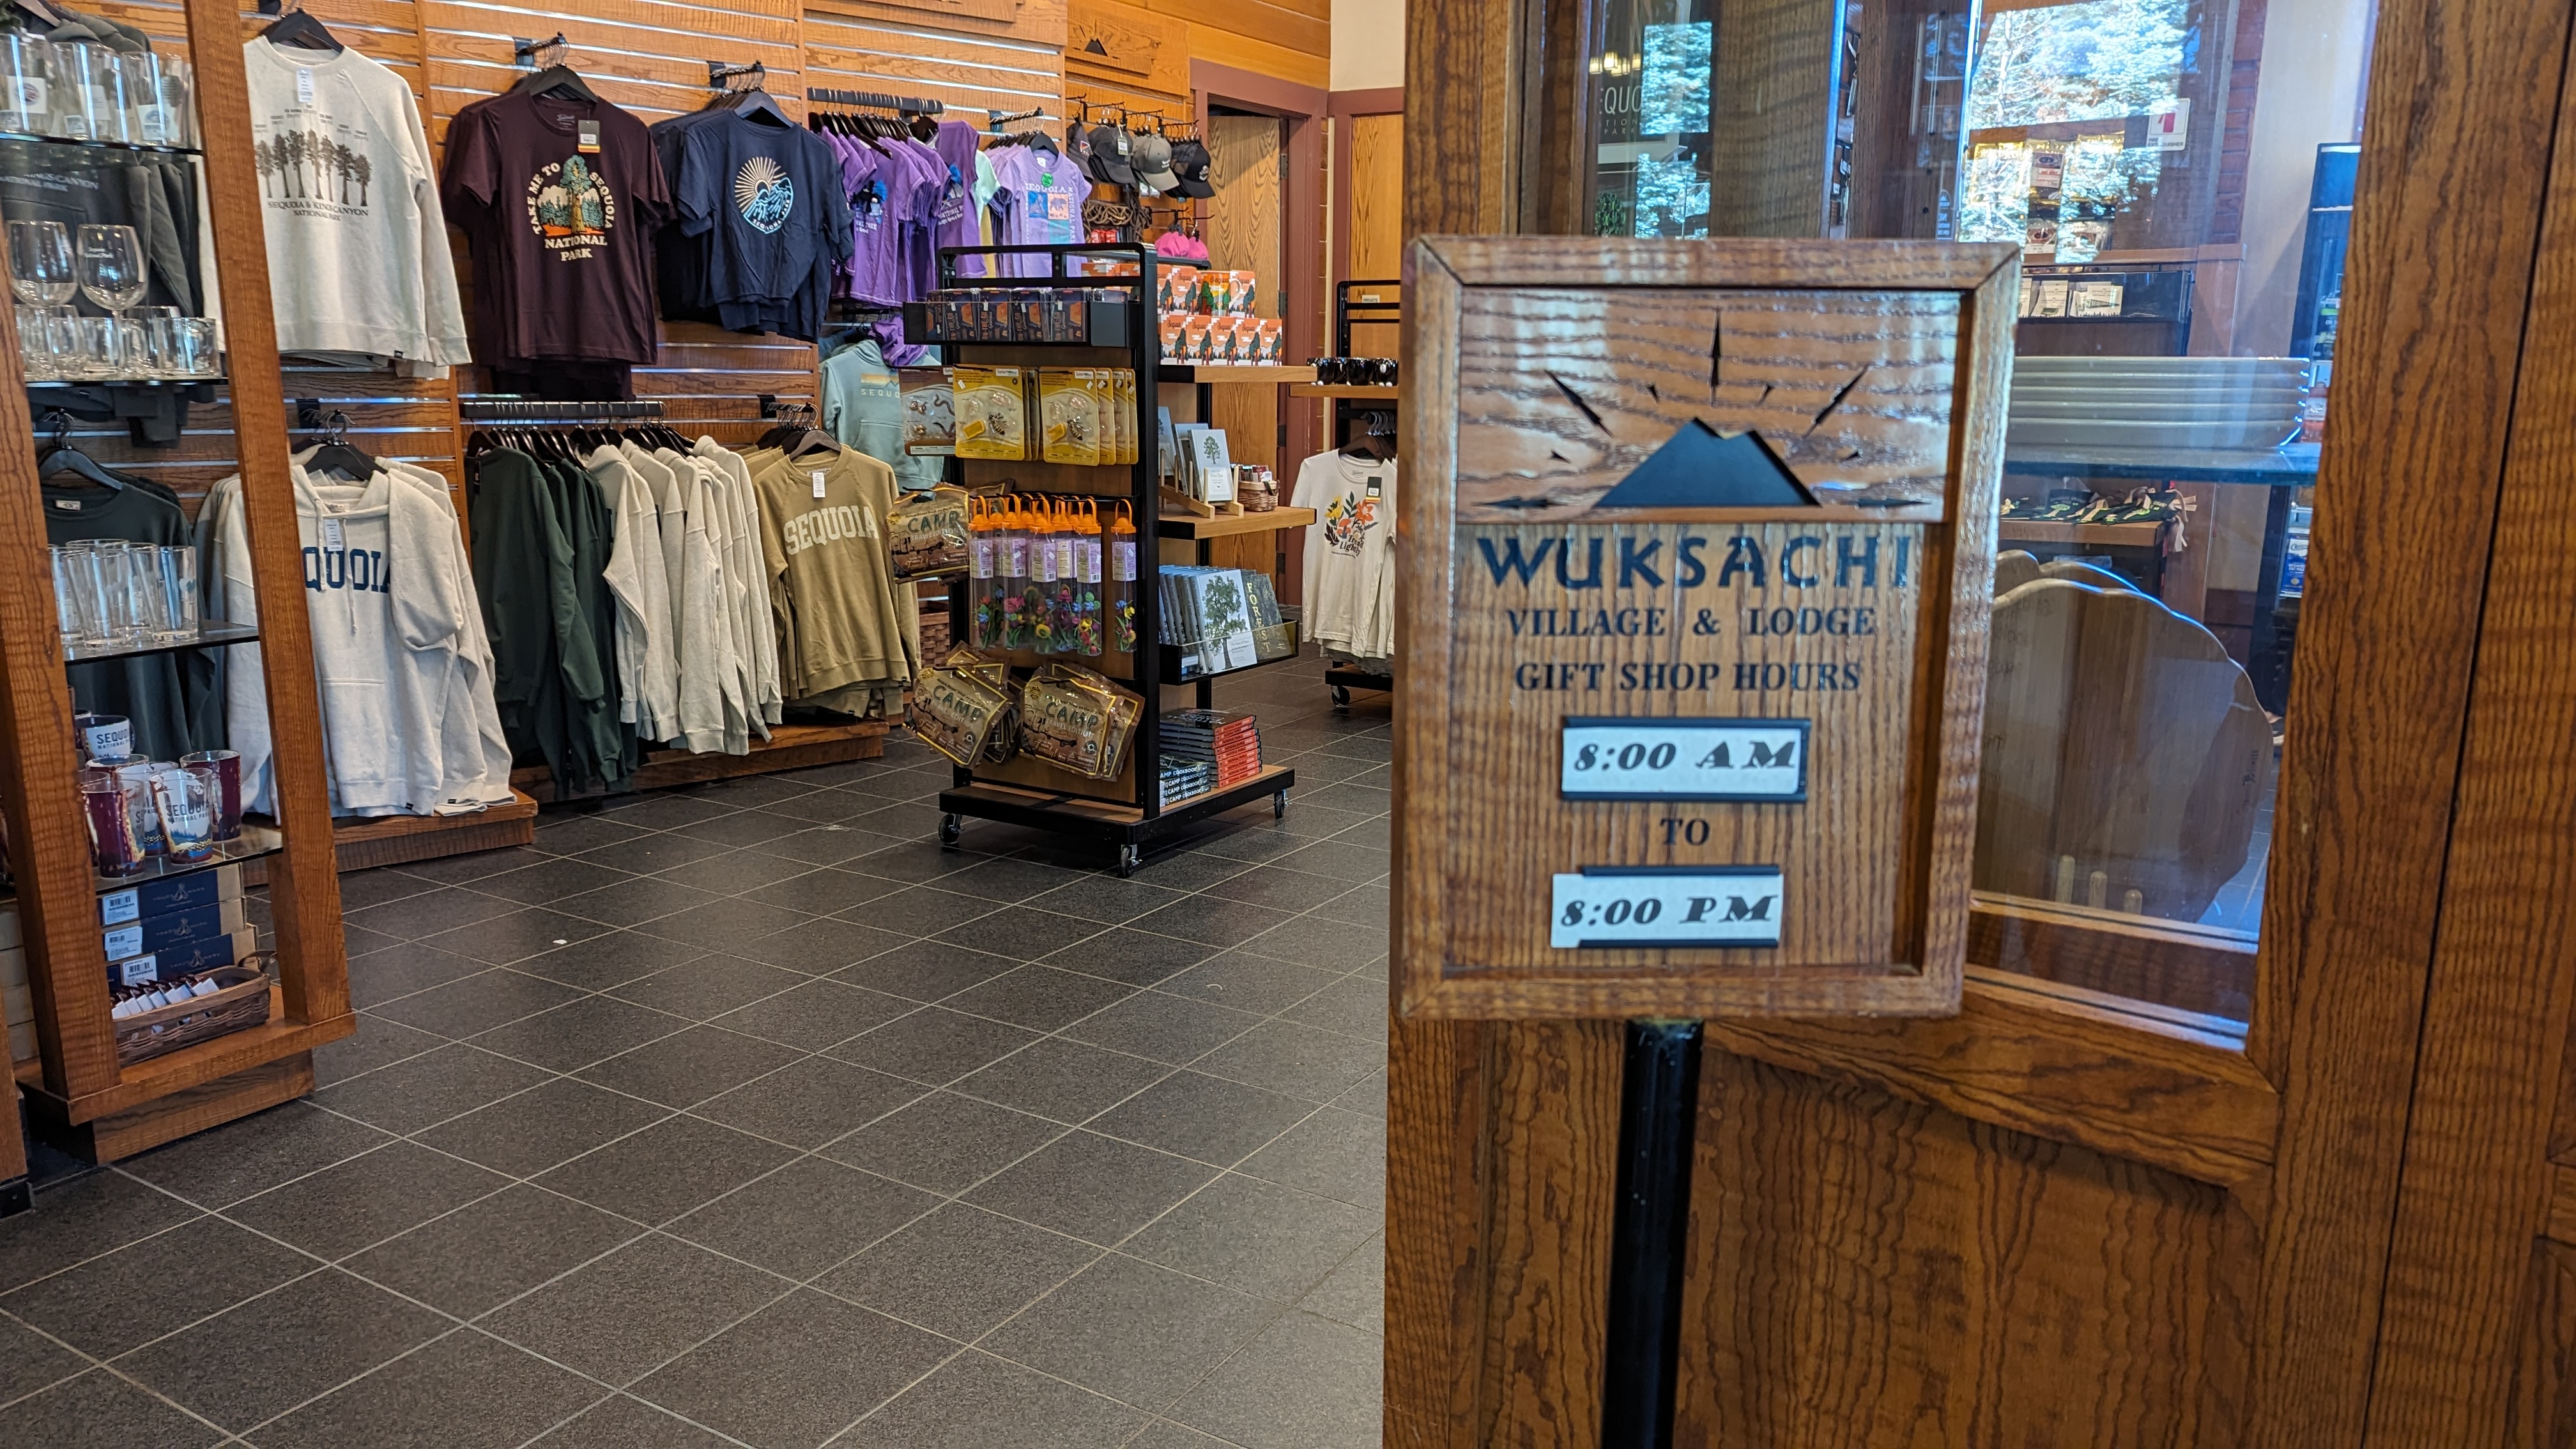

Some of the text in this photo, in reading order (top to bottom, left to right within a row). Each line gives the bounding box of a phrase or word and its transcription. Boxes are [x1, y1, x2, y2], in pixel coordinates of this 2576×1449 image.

[267, 201, 305, 210] SEQUOIA
[332, 206, 369, 216] CANYON
[526, 162, 560, 234] TAKE ME TO
[589, 171, 615, 229] SEQUOIA
[293, 210, 327, 218] NATIONAL
[544, 235, 608, 249] NATIONAL
[560, 248, 593, 262] PARK
[861, 389, 900, 397] SEQUO
[783, 505, 879, 555] SEQUOIA
[908, 510, 959, 533] CAMP
[933, 528, 959, 537] EDITION
[1339, 542, 1361, 557] Lightly
[1348, 534, 1365, 549] Tread
[302, 546, 390, 593] QUOI
[1476, 536, 1911, 590] WUKSACHI
[1507, 608, 1876, 637] VILLAGE & LODGE
[1516, 663, 1861, 691] GIFT SHOP HOURS
[933, 685, 982, 721] CAMP
[1046, 702, 1098, 728] CAMP
[1046, 717, 1094, 739] TRAVEL EDITION
[97, 740, 125, 749] NATIONAL
[1573, 740, 1795, 772] 8:00 AM
[1168, 772, 1199, 786] CAMP COOKBOOK
[1172, 767, 1197, 776] COOKBOOK
[1167, 781, 1200, 795] CAMP COOKBOOK
[1169, 788, 1201, 802] CAMP COOKBOOK
[1660, 818, 1710, 847] TO
[1560, 894, 1778, 926] 8:00 PM
